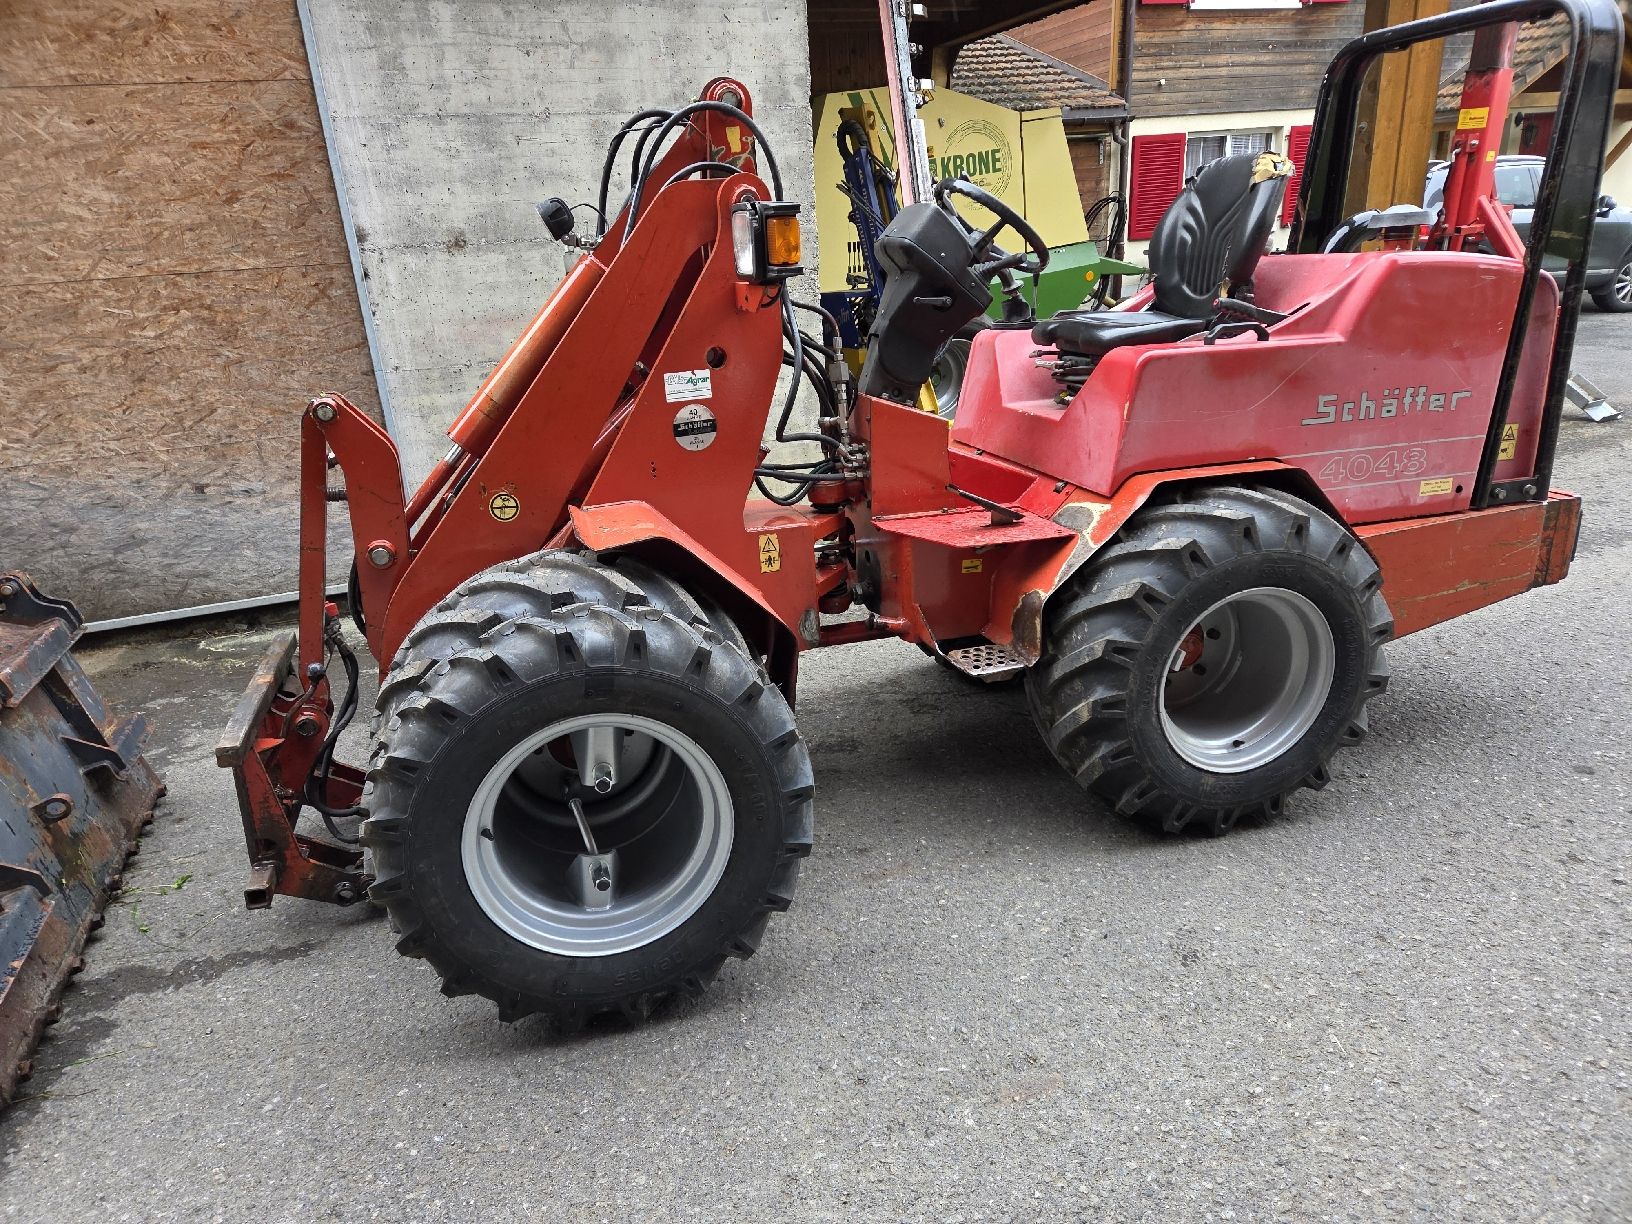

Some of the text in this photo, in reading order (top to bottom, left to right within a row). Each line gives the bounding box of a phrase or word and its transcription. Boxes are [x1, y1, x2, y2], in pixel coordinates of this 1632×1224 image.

[941, 148, 1002, 179] KRONE
[1301, 386, 1472, 426] Schäffer
[1318, 448, 1427, 483] 4048
